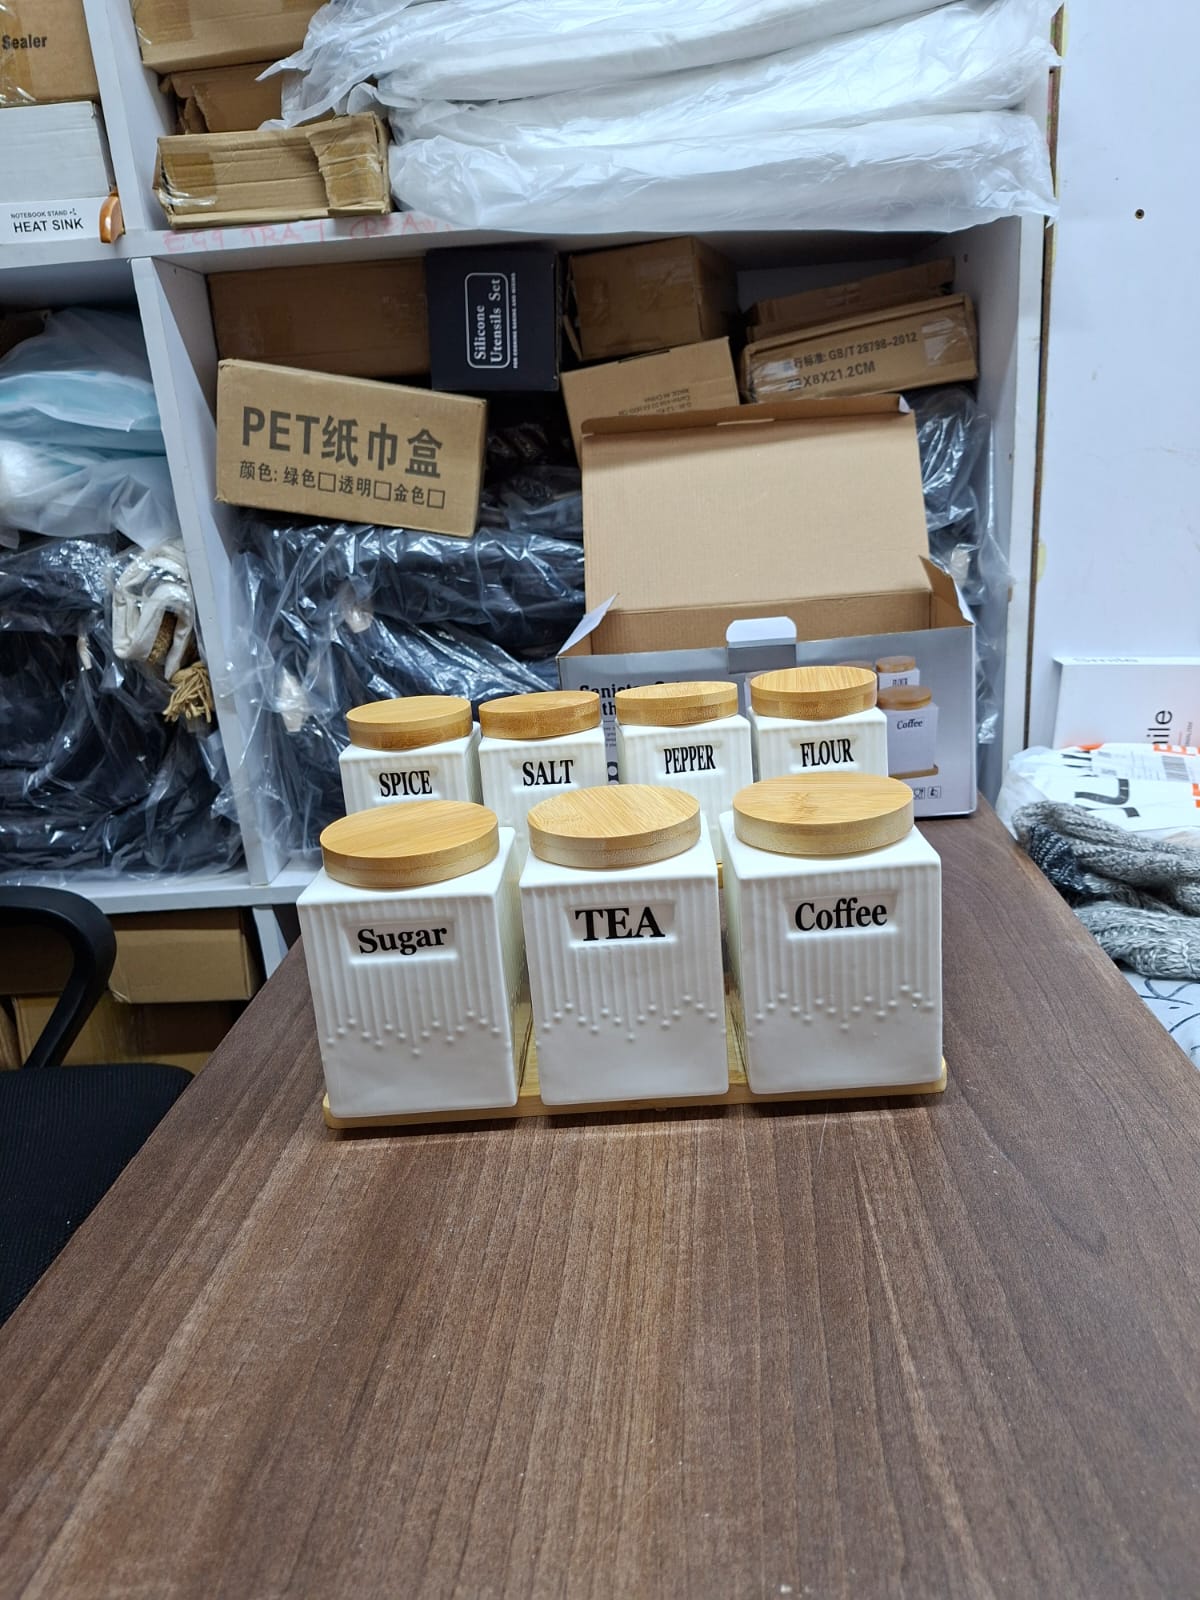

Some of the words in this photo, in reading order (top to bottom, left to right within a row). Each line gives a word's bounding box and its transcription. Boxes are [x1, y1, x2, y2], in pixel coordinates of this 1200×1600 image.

[2, 34, 48, 50] Sealer
[10, 211, 46, 219] NOTEBOOK
[47, 209, 68, 217] STAND
[14, 220, 48, 233] HEAT
[52, 218, 84, 231] SINK
[488, 279, 501, 301] Set
[474, 305, 486, 360] Silicone
[489, 307, 503, 362] Utensils
[242, 406, 443, 479] PET纸巾盒
[896, 718, 923, 730] Coffee
[664, 744, 716, 775] PEPPER
[800, 738, 854, 768] FLOUR
[379, 770, 433, 797] SPICE
[522, 759, 574, 786] SALT
[575, 906, 666, 941] TEA
[795, 898, 888, 931] Coffee
[357, 927, 448, 956] Sugar
